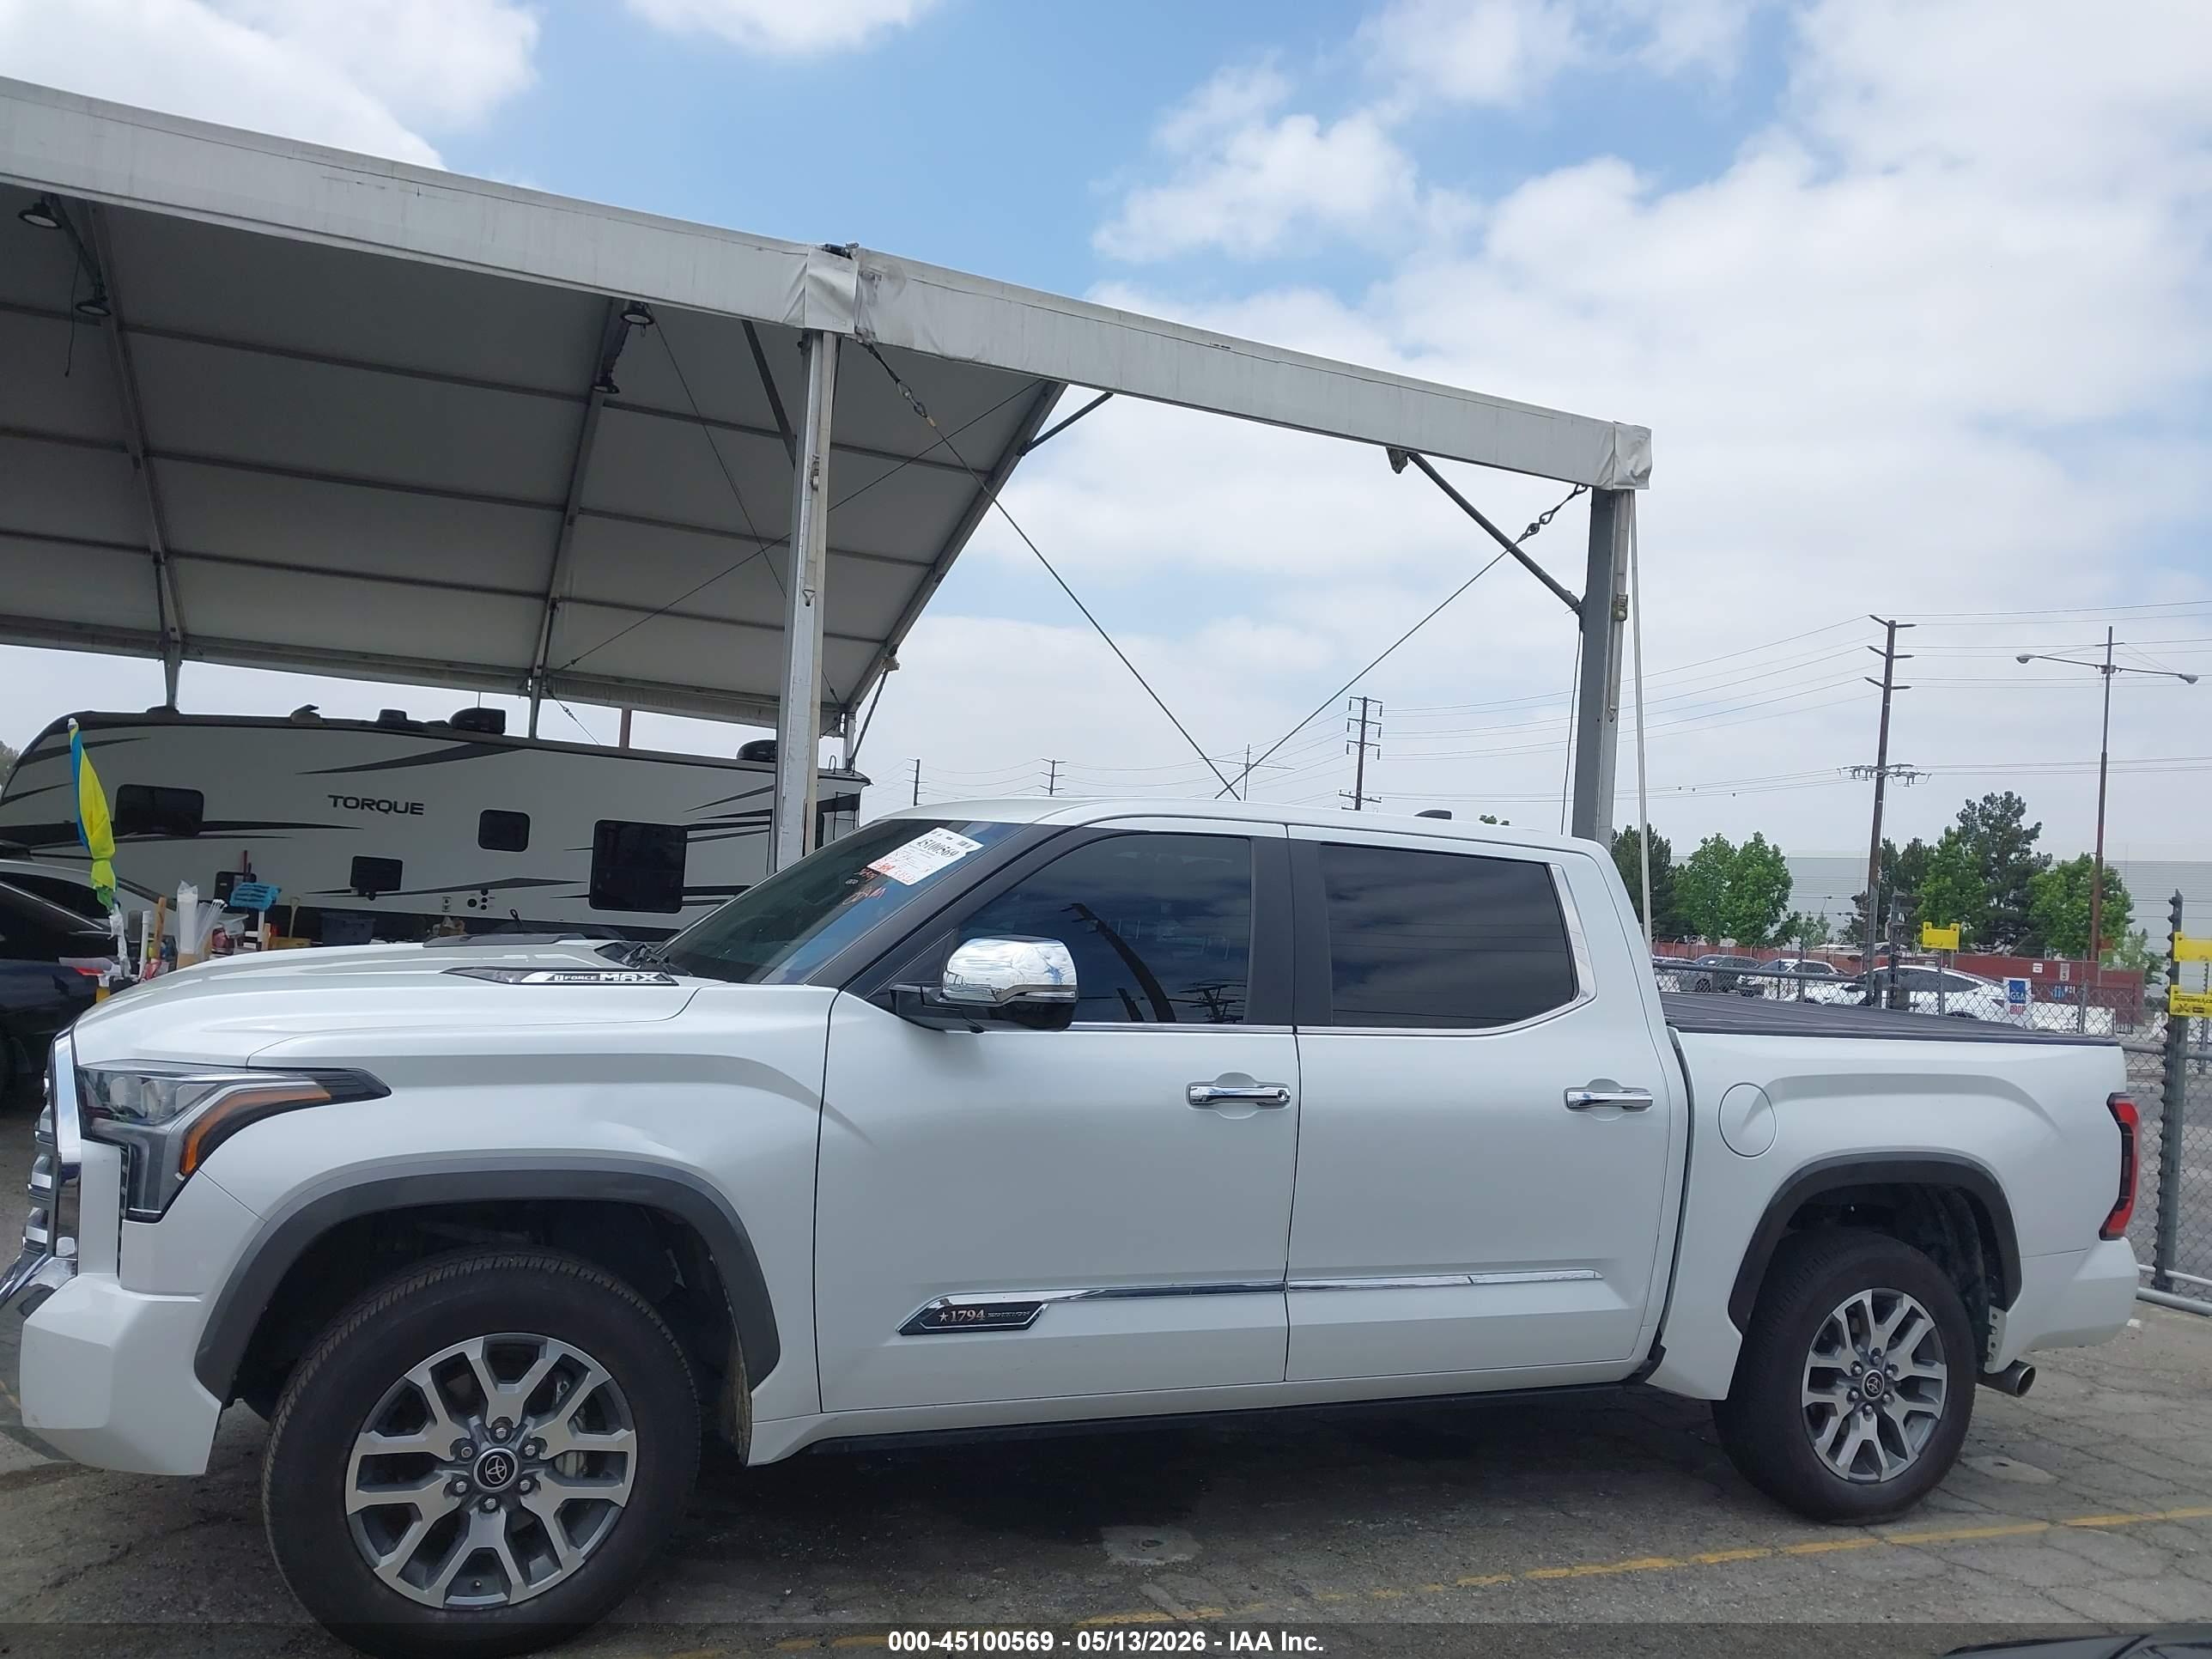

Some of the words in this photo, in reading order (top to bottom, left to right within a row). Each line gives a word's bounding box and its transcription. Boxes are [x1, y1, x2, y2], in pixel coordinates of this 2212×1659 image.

[327, 794, 424, 816] TORQUE
[599, 973, 659, 981] MAX
[2010, 992, 2026, 1001] GSA
[950, 1310, 986, 1322] 1794
